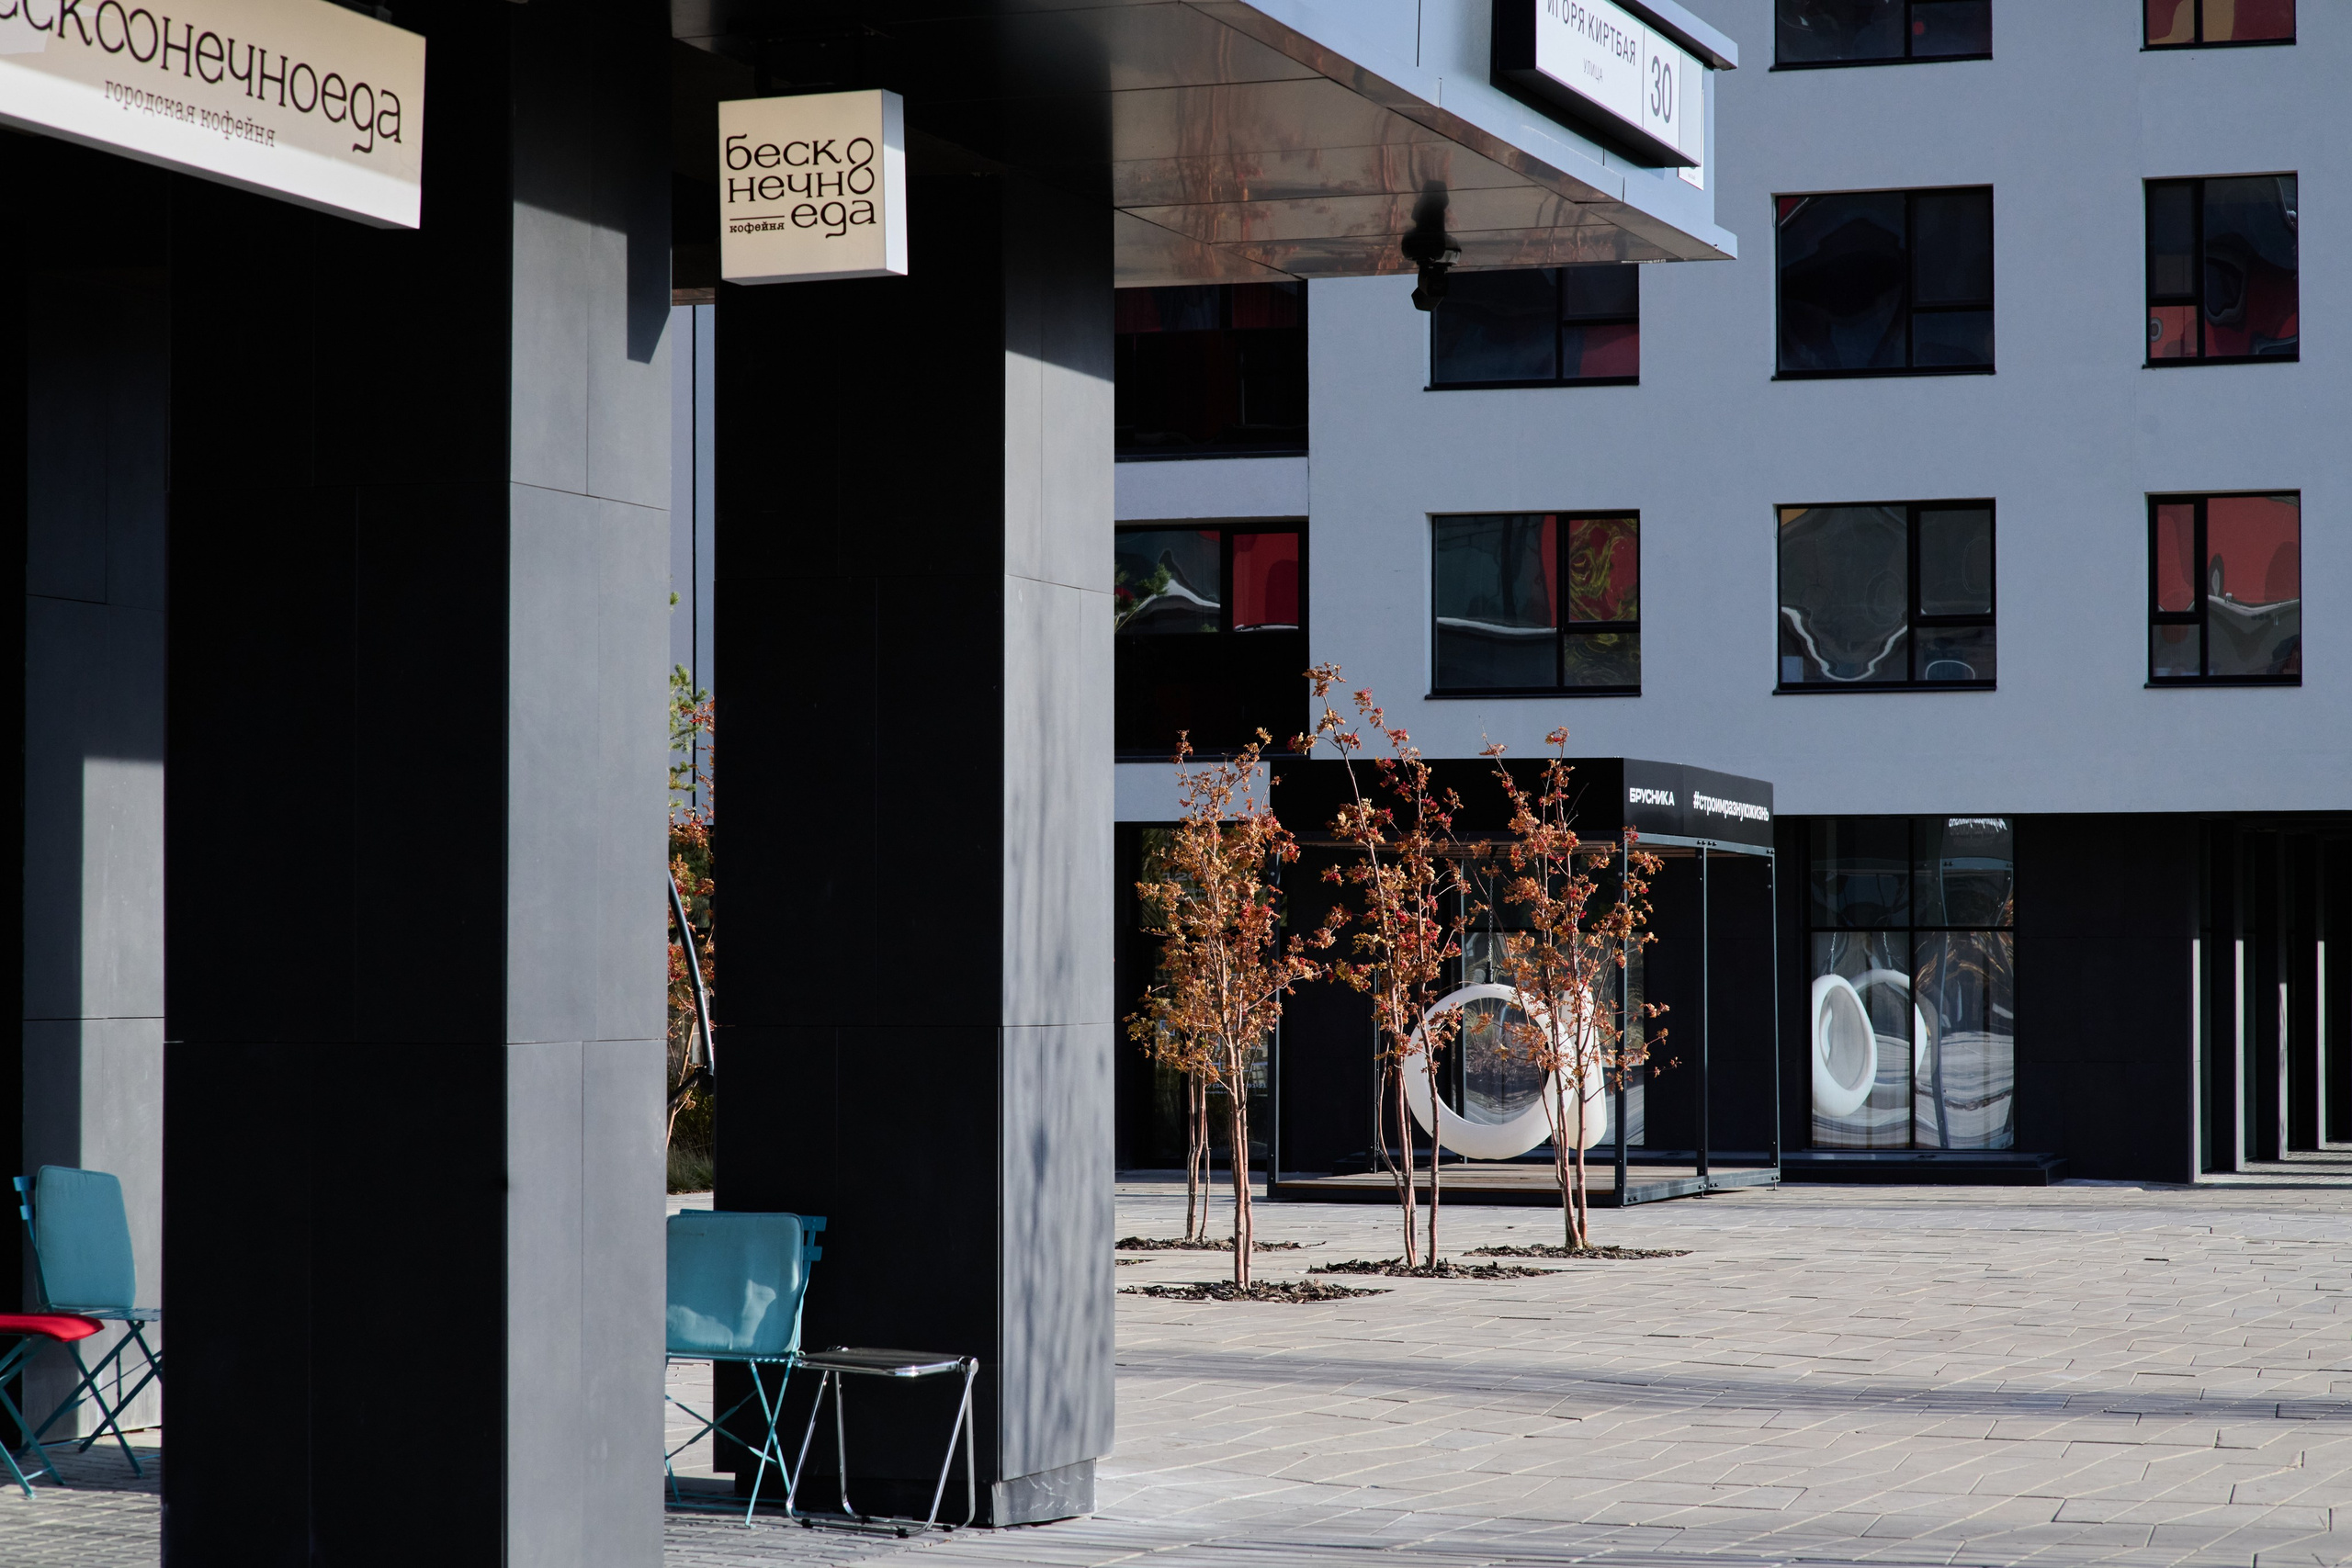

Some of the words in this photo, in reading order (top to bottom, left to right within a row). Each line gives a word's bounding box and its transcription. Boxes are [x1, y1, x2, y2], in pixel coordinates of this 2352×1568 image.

[1588, 12, 1636, 66] КИРТБАЯ
[1583, 58, 1603, 84] УЛИЦА
[1651, 55, 1672, 124] 30
[105, 79, 196, 124] городская
[200, 108, 276, 148] кофейня
[729, 221, 785, 234] кофейня
[791, 199, 876, 239] еда
[1629, 787, 1675, 807] БРУСНИКА
[1692, 790, 1770, 822] #строимразнуюжизнь
